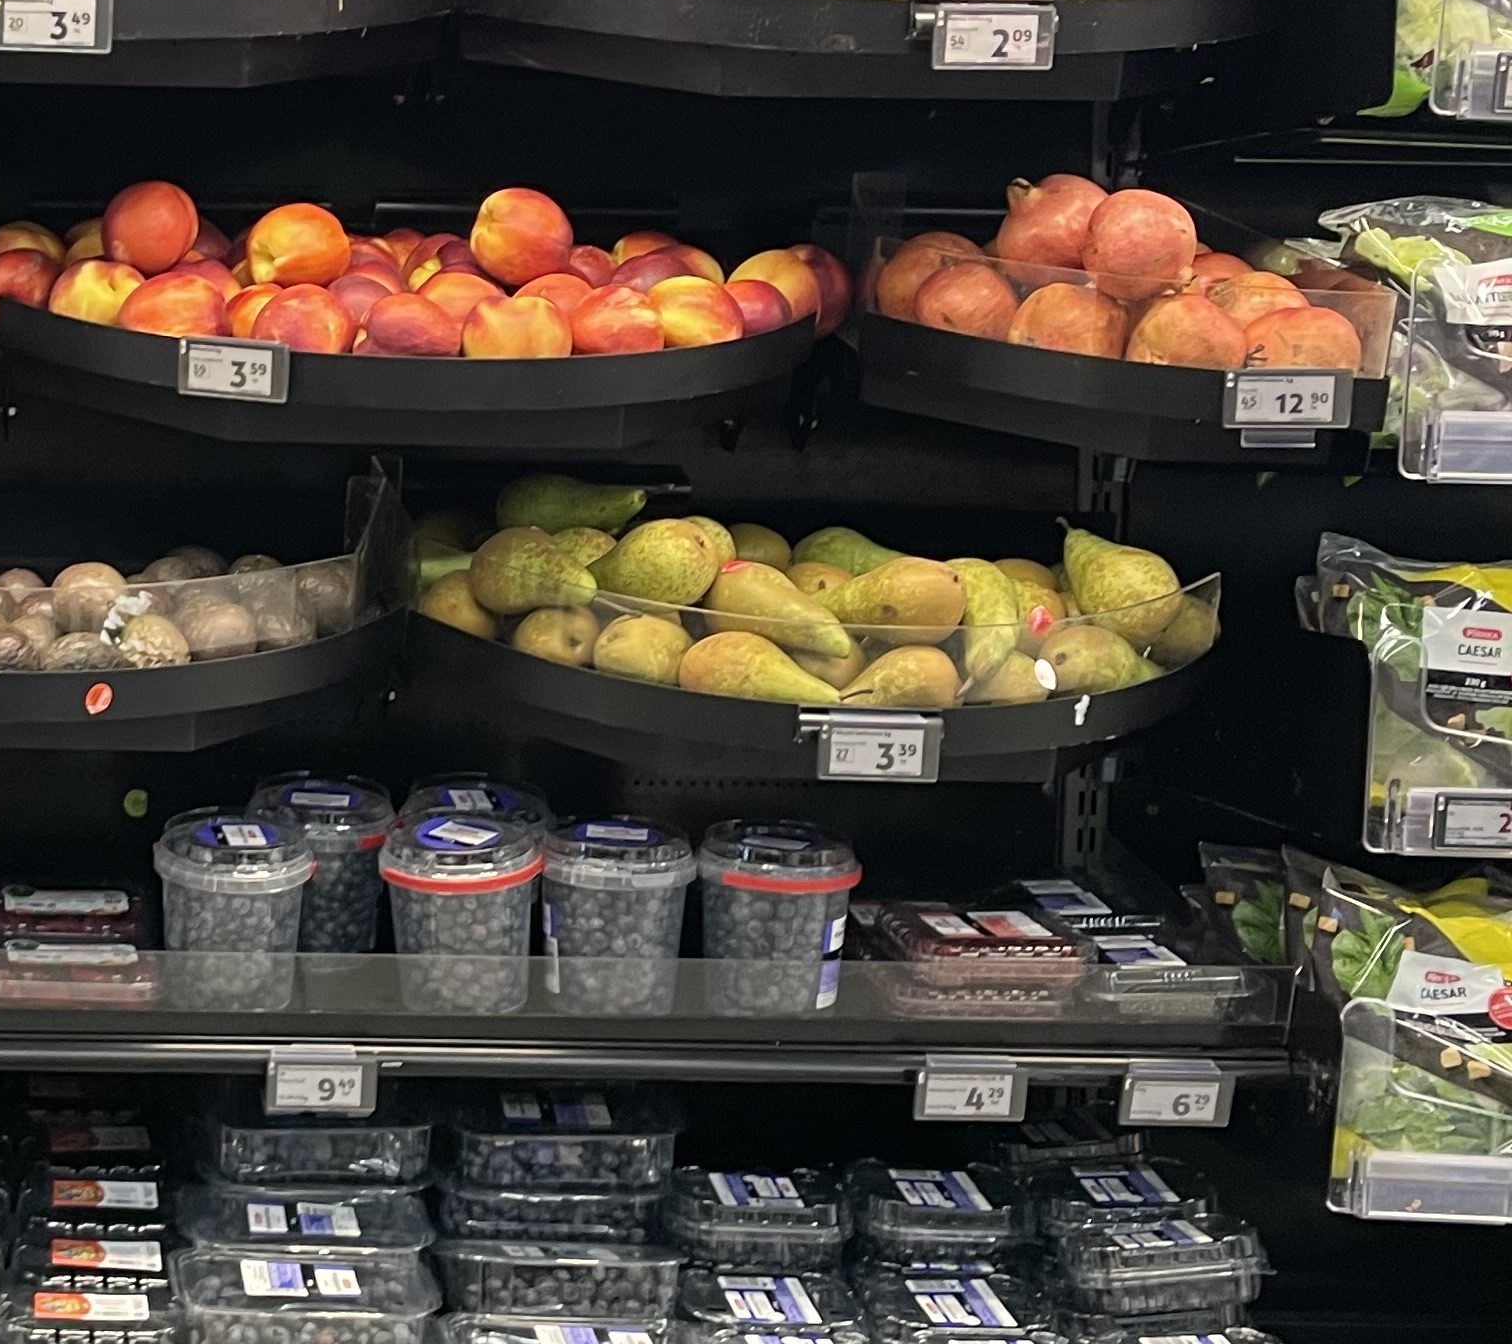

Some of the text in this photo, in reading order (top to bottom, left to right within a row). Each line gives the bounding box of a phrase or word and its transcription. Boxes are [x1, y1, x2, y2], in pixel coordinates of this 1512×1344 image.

[1274, 392, 1304, 414] 12
[1458, 644, 1502, 658] CAESAR
[1420, 987, 1467, 1001] CAESAR
